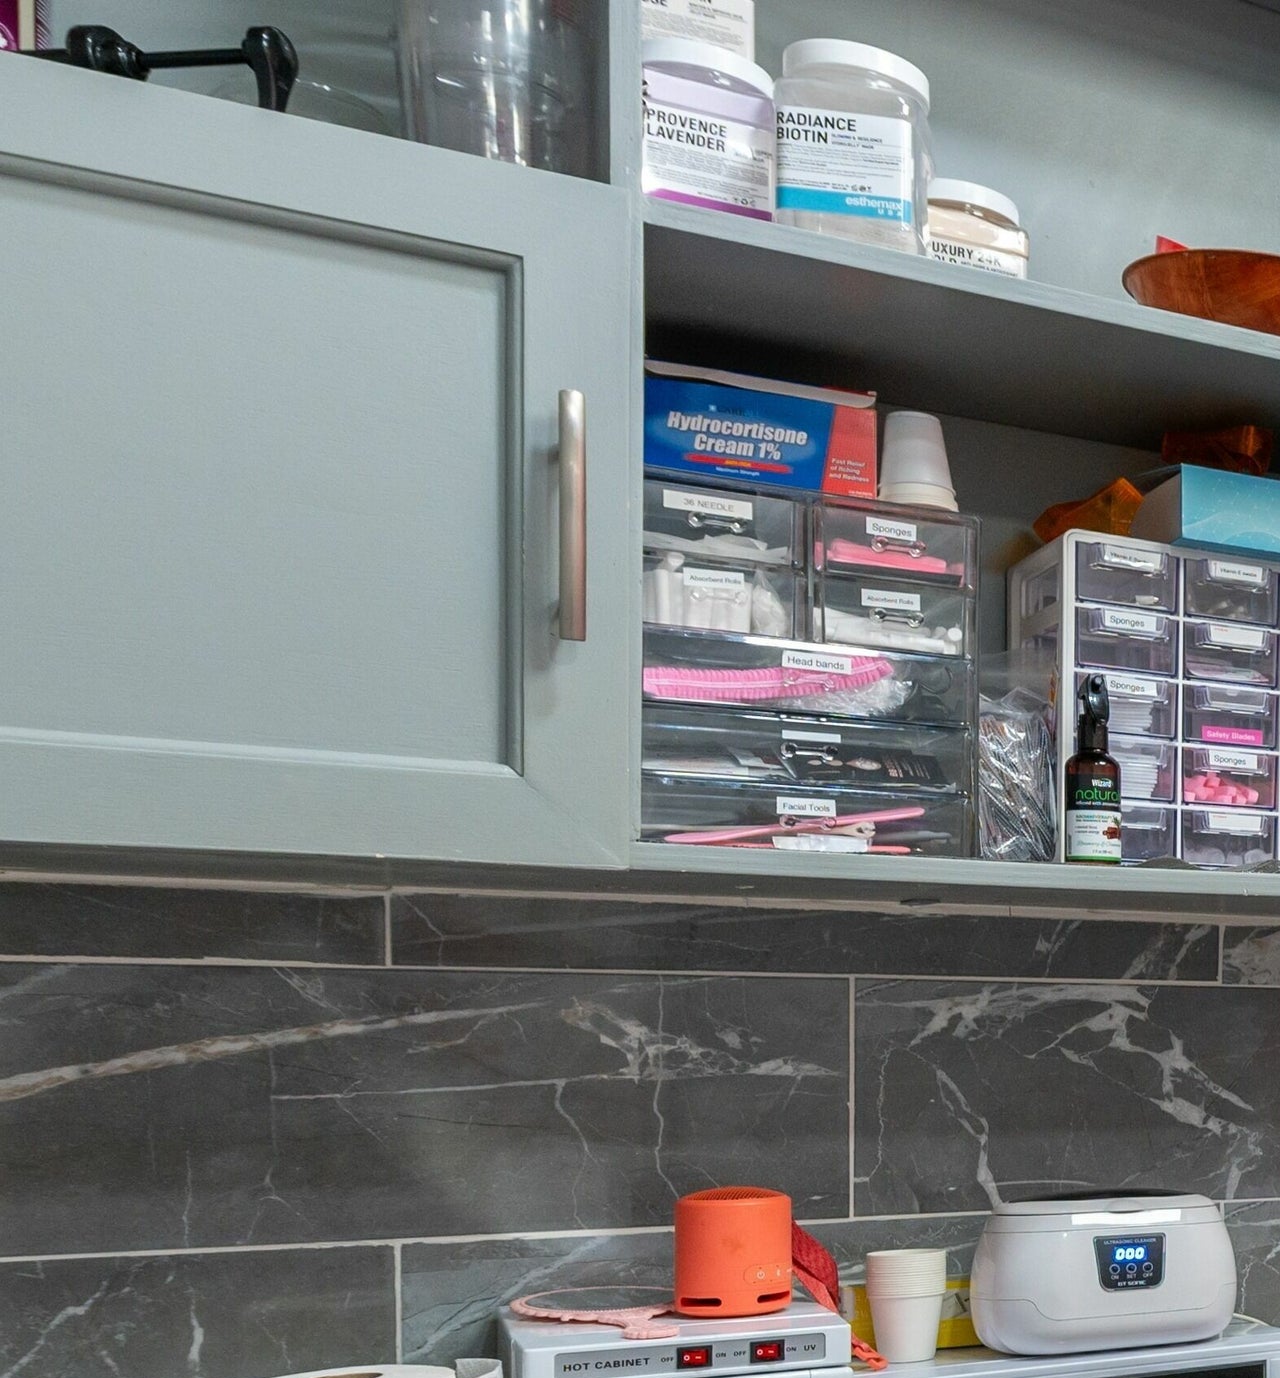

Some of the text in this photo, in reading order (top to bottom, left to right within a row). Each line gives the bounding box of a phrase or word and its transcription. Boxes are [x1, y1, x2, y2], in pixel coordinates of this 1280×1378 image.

[647, 108, 727, 138] PROVENCE
[776, 111, 857, 132] RADIANCE
[647, 123, 726, 152] LAVENDER
[776, 126, 828, 144] BIOTIN
[845, 196, 903, 209] esthemax
[928, 241, 974, 260] UXURY
[667, 410, 808, 446] Hydrocortisone
[693, 433, 782, 461] Cream 1%
[697, 499, 735, 513] NEEDLE
[871, 522, 913, 538] Sponges
[1109, 614, 1145, 628] Sponges
[787, 655, 845, 670] Head bands
[1110, 679, 1145, 693] Sponges
[1206, 729, 1256, 742] Safety Blades
[1213, 754, 1247, 767] Sponges
[782, 801, 831, 813] Facial Tools
[1115, 1246, 1145, 1261] 000
[563, 1362, 591, 1373] HOT
[594, 1357, 651, 1370] CABINET
